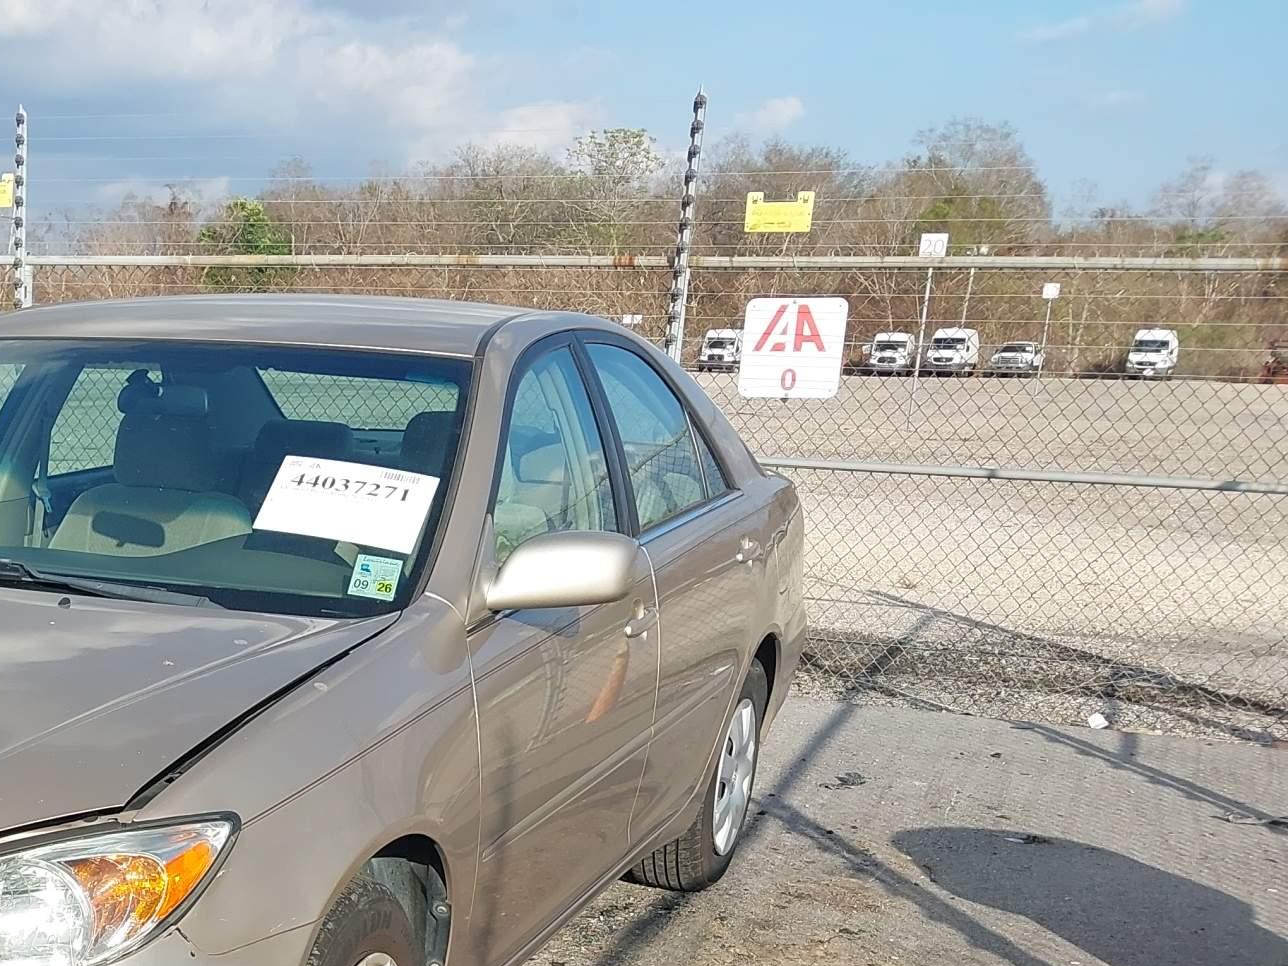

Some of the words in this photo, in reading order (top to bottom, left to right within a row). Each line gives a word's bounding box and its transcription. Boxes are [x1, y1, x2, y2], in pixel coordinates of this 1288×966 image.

[920, 239, 945, 256] 20
[780, 368, 797, 391] 0
[290, 472, 411, 502] 44037271
[353, 578, 369, 590] 09
[376, 582, 393, 594] 26
